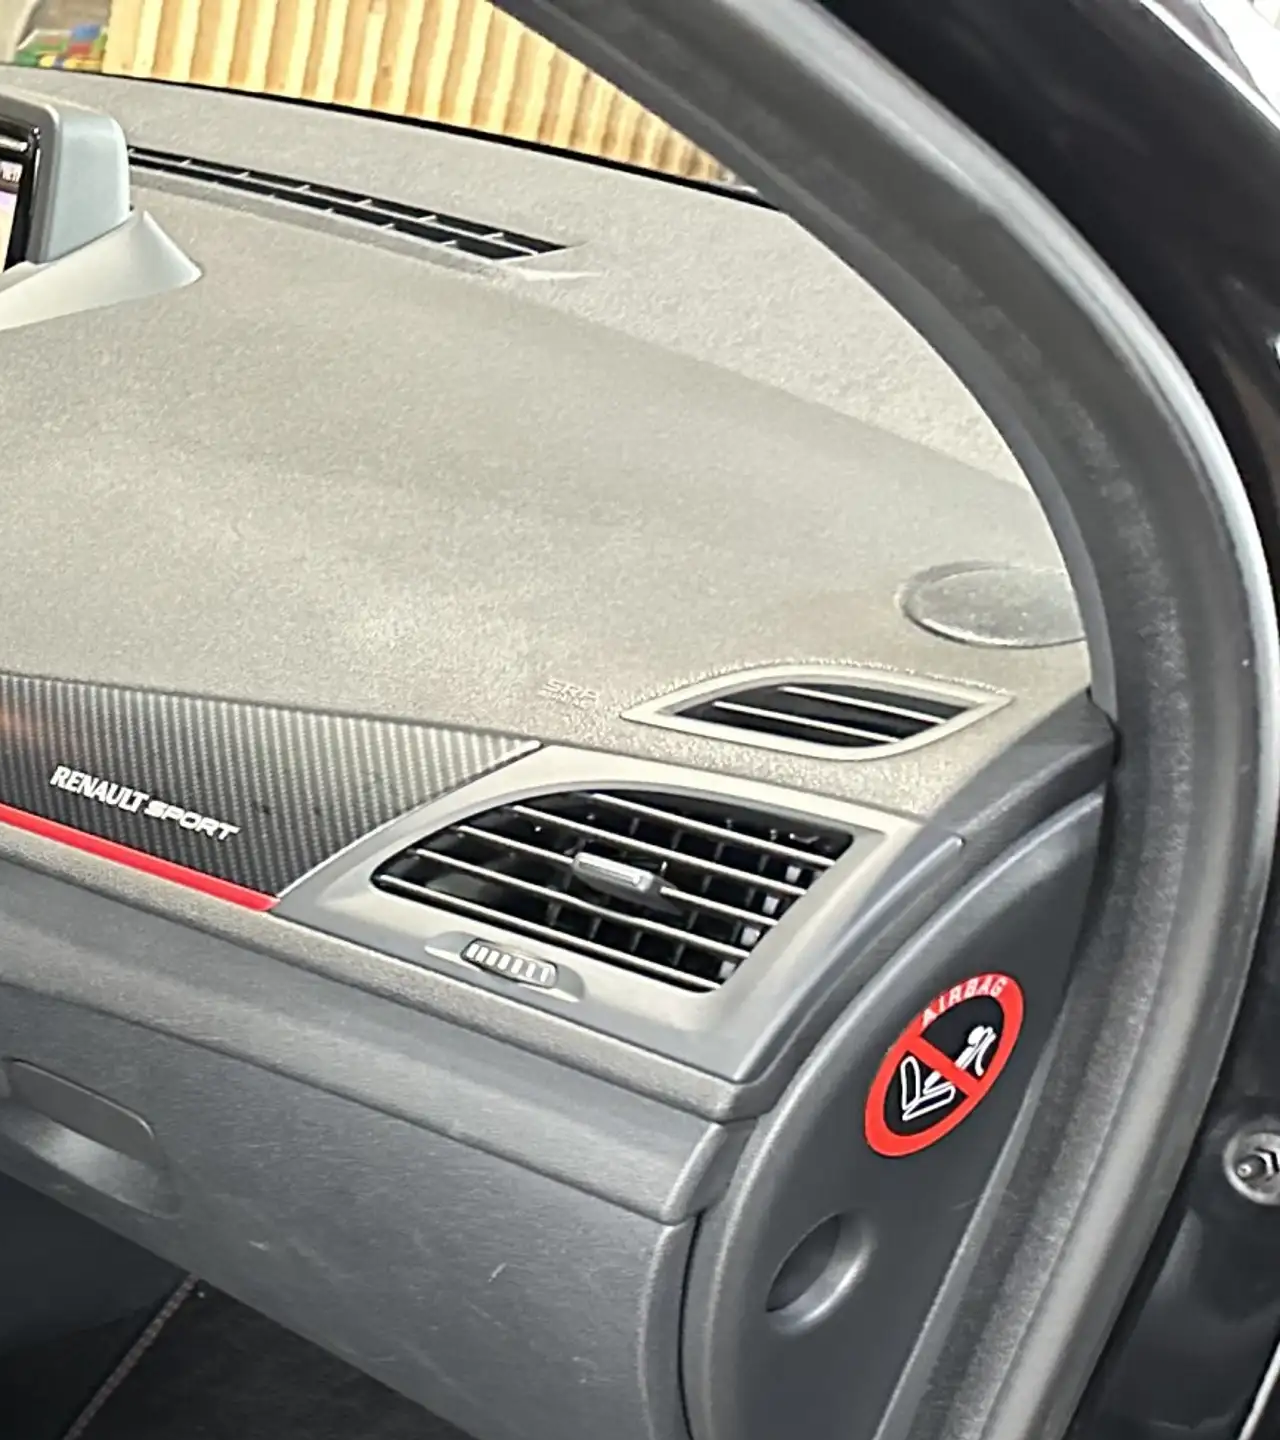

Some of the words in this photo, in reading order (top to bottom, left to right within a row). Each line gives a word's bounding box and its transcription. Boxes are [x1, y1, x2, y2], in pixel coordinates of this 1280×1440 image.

[49, 764, 150, 814] RENAULT
[143, 800, 241, 842] SPORT
[920, 974, 1009, 1029] AIRBAG
